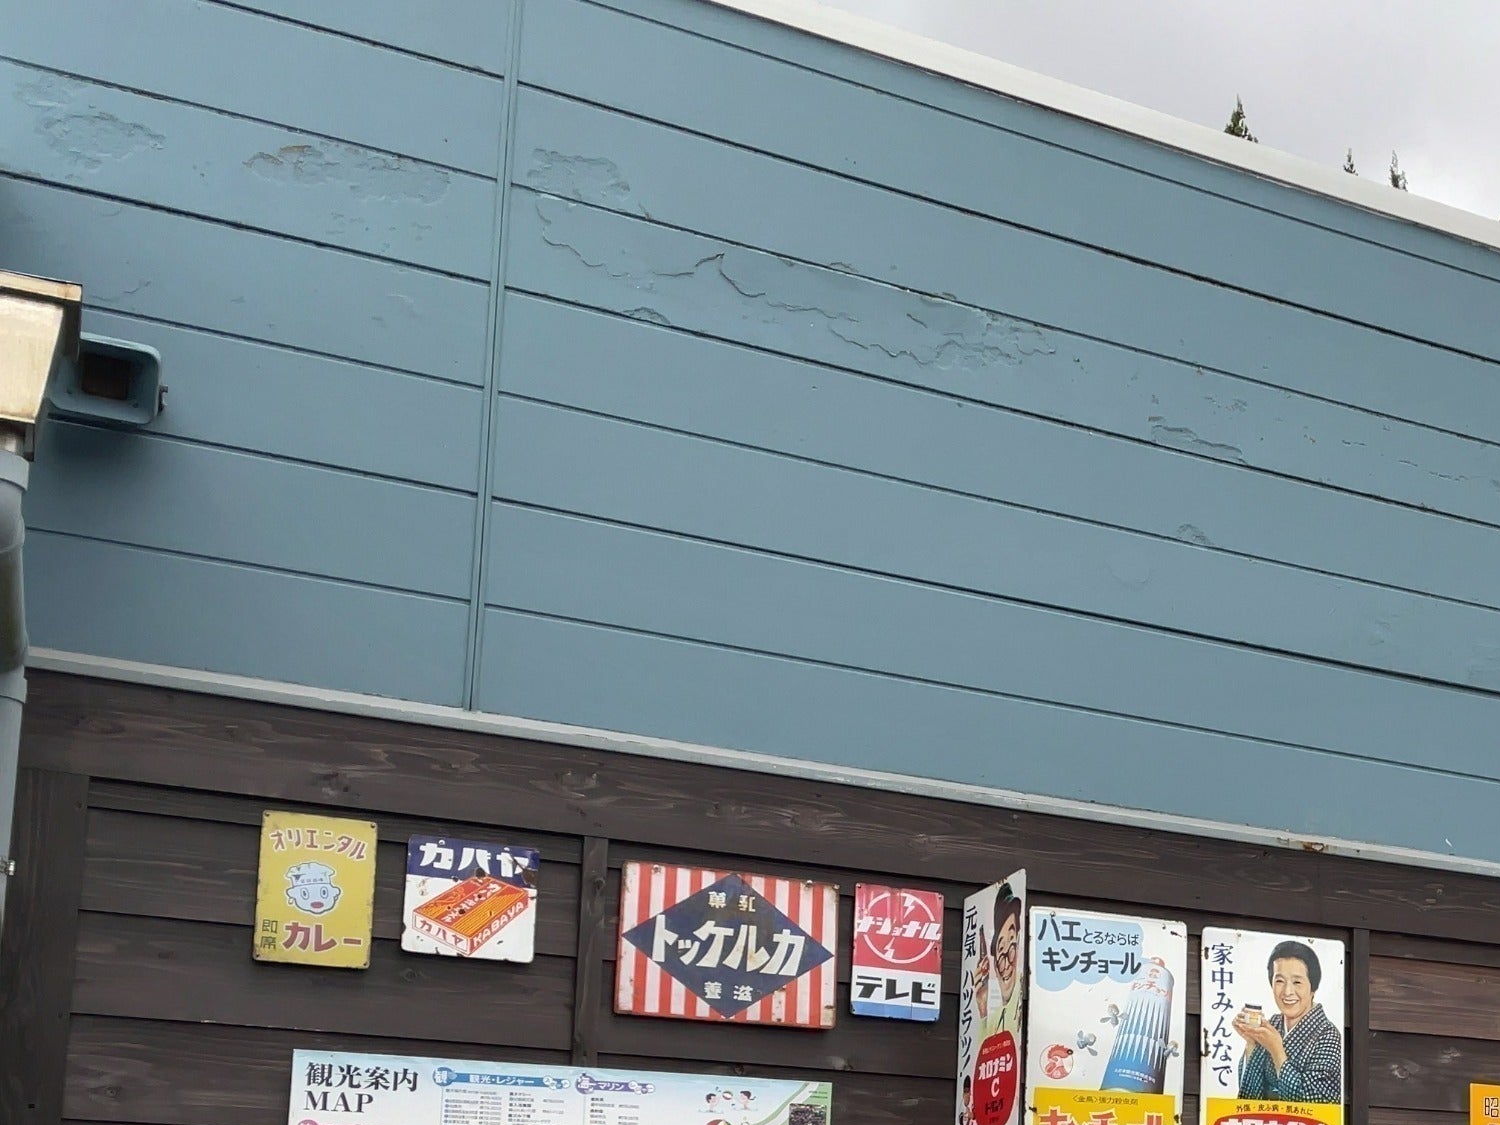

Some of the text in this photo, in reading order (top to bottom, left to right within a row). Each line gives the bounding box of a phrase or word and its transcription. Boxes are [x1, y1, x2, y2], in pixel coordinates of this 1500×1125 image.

[270, 828, 367, 861] オリエンタル
[282, 922, 362, 951] カレー
[857, 917, 942, 940] ナショナル
[964, 905, 977, 961] 元気
[1037, 918, 1139, 947] ハエとるならば
[1042, 947, 1142, 976] キンチョール
[856, 975, 936, 1005] テレビ
[1210, 943, 1235, 1088] 家中みんなで
[306, 1062, 419, 1092] 観光案内
[979, 1053, 1013, 1080] オロナミン
[991, 1077, 999, 1097] C
[304, 1091, 374, 1113] MAP
